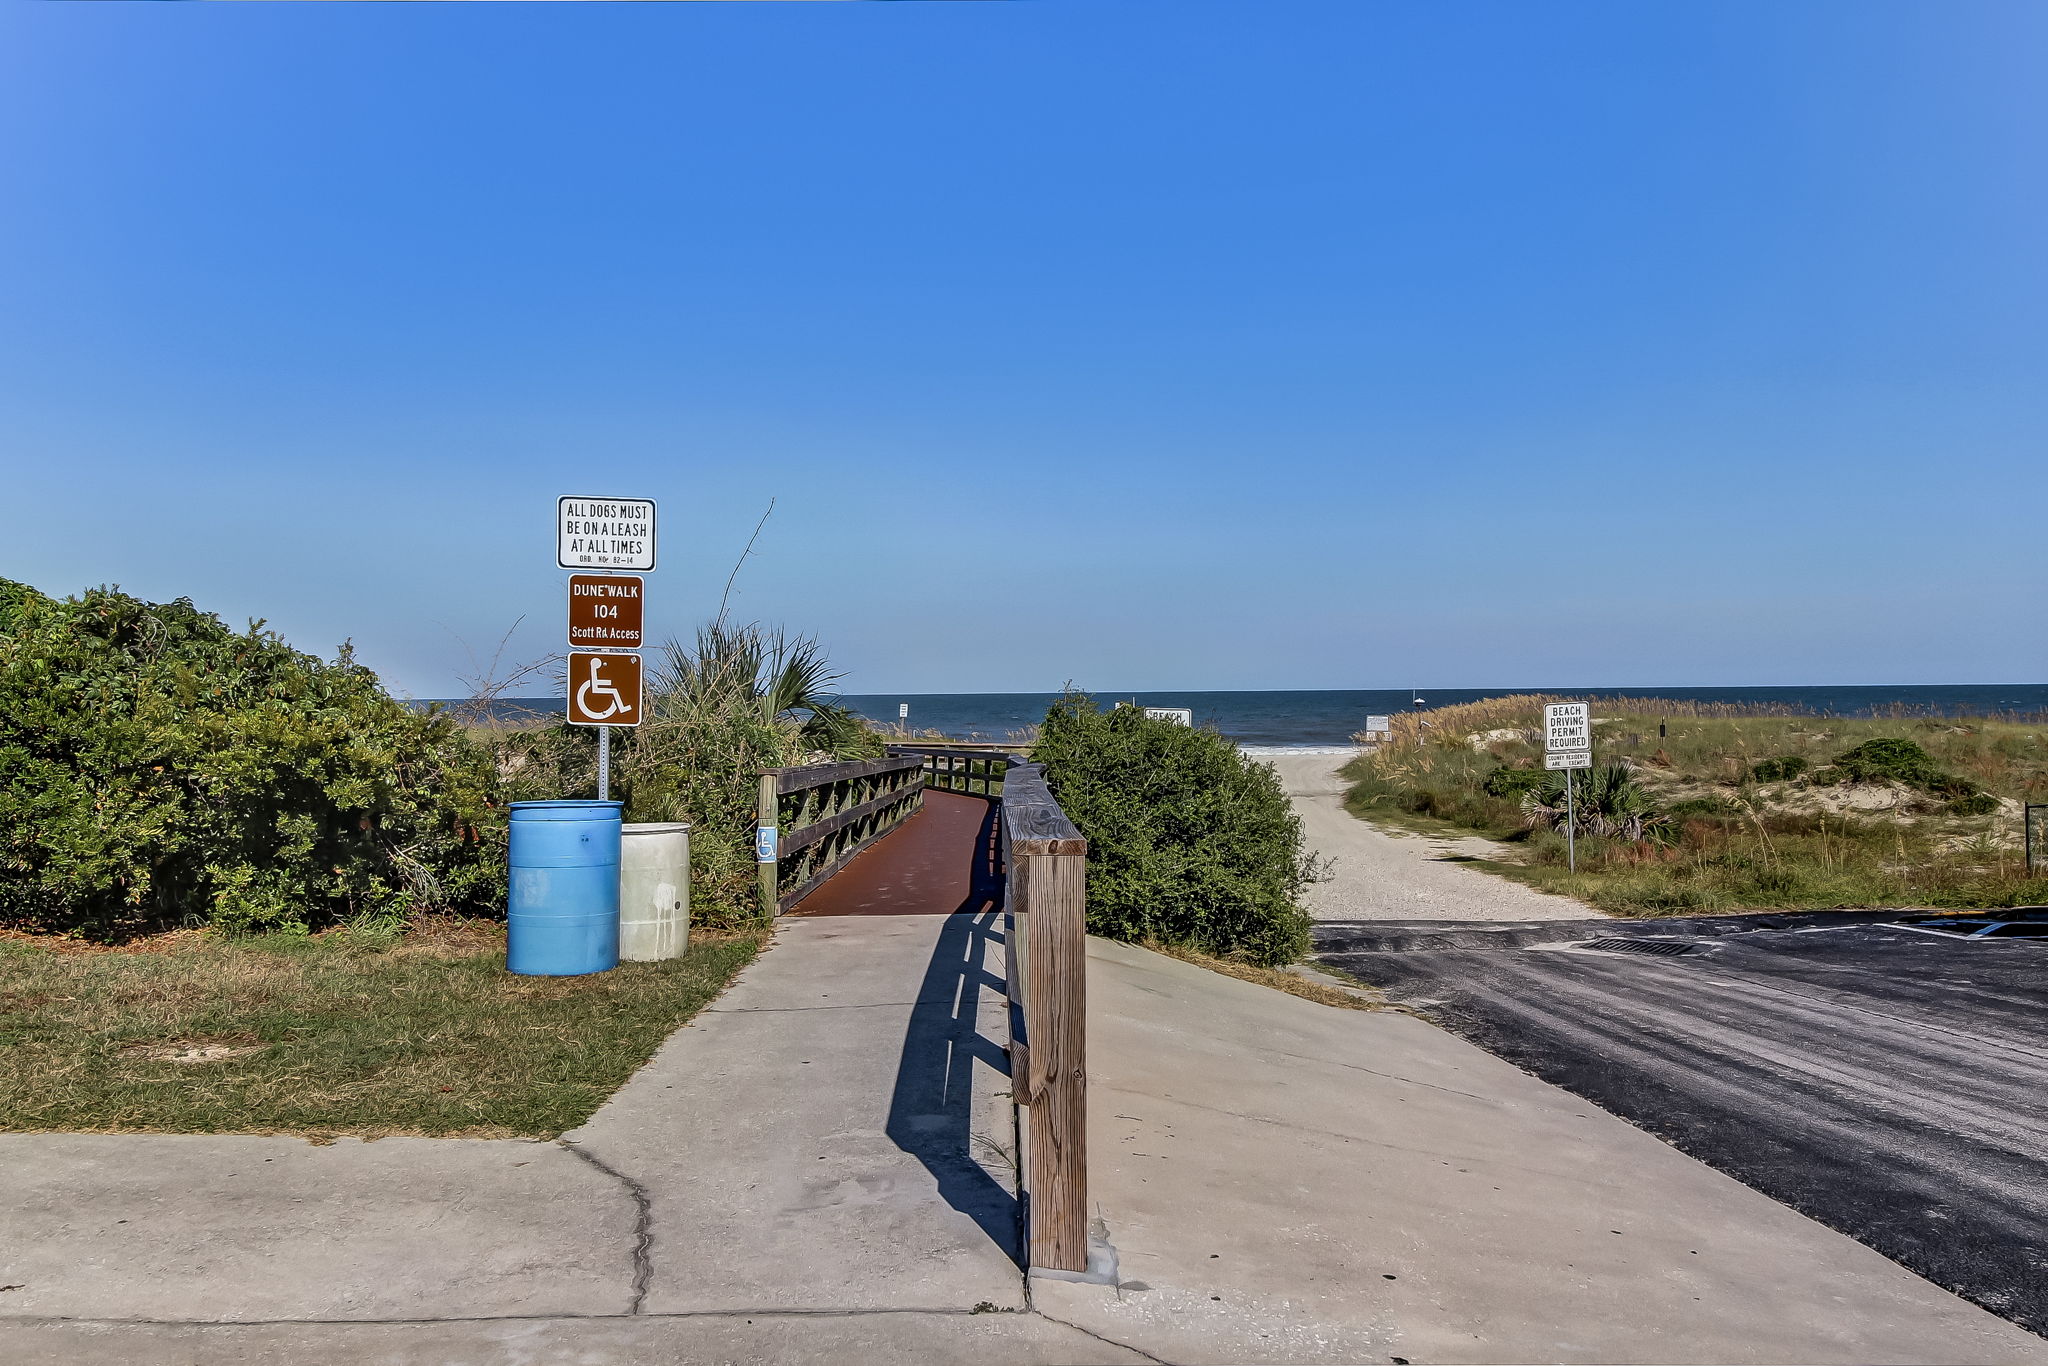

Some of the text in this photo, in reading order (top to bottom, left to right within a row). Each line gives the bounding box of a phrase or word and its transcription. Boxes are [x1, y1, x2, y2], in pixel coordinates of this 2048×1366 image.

[567, 503, 647, 519] ALL DOGS MUST
[567, 521, 647, 537] BE ON A LEASH
[571, 539, 643, 554] AT ALL TIMES
[574, 584, 638, 598] DUNE WALK
[594, 604, 618, 619] 104
[572, 626, 595, 638] Scott
[609, 627, 640, 640] Access
[1153, 712, 1182, 720] BEACH
[1552, 706, 1581, 716] BEACH
[1550, 716, 1584, 726] DRIVING
[1552, 727, 1582, 737] PERMIT
[1550, 737, 1586, 748] REQUIRED
